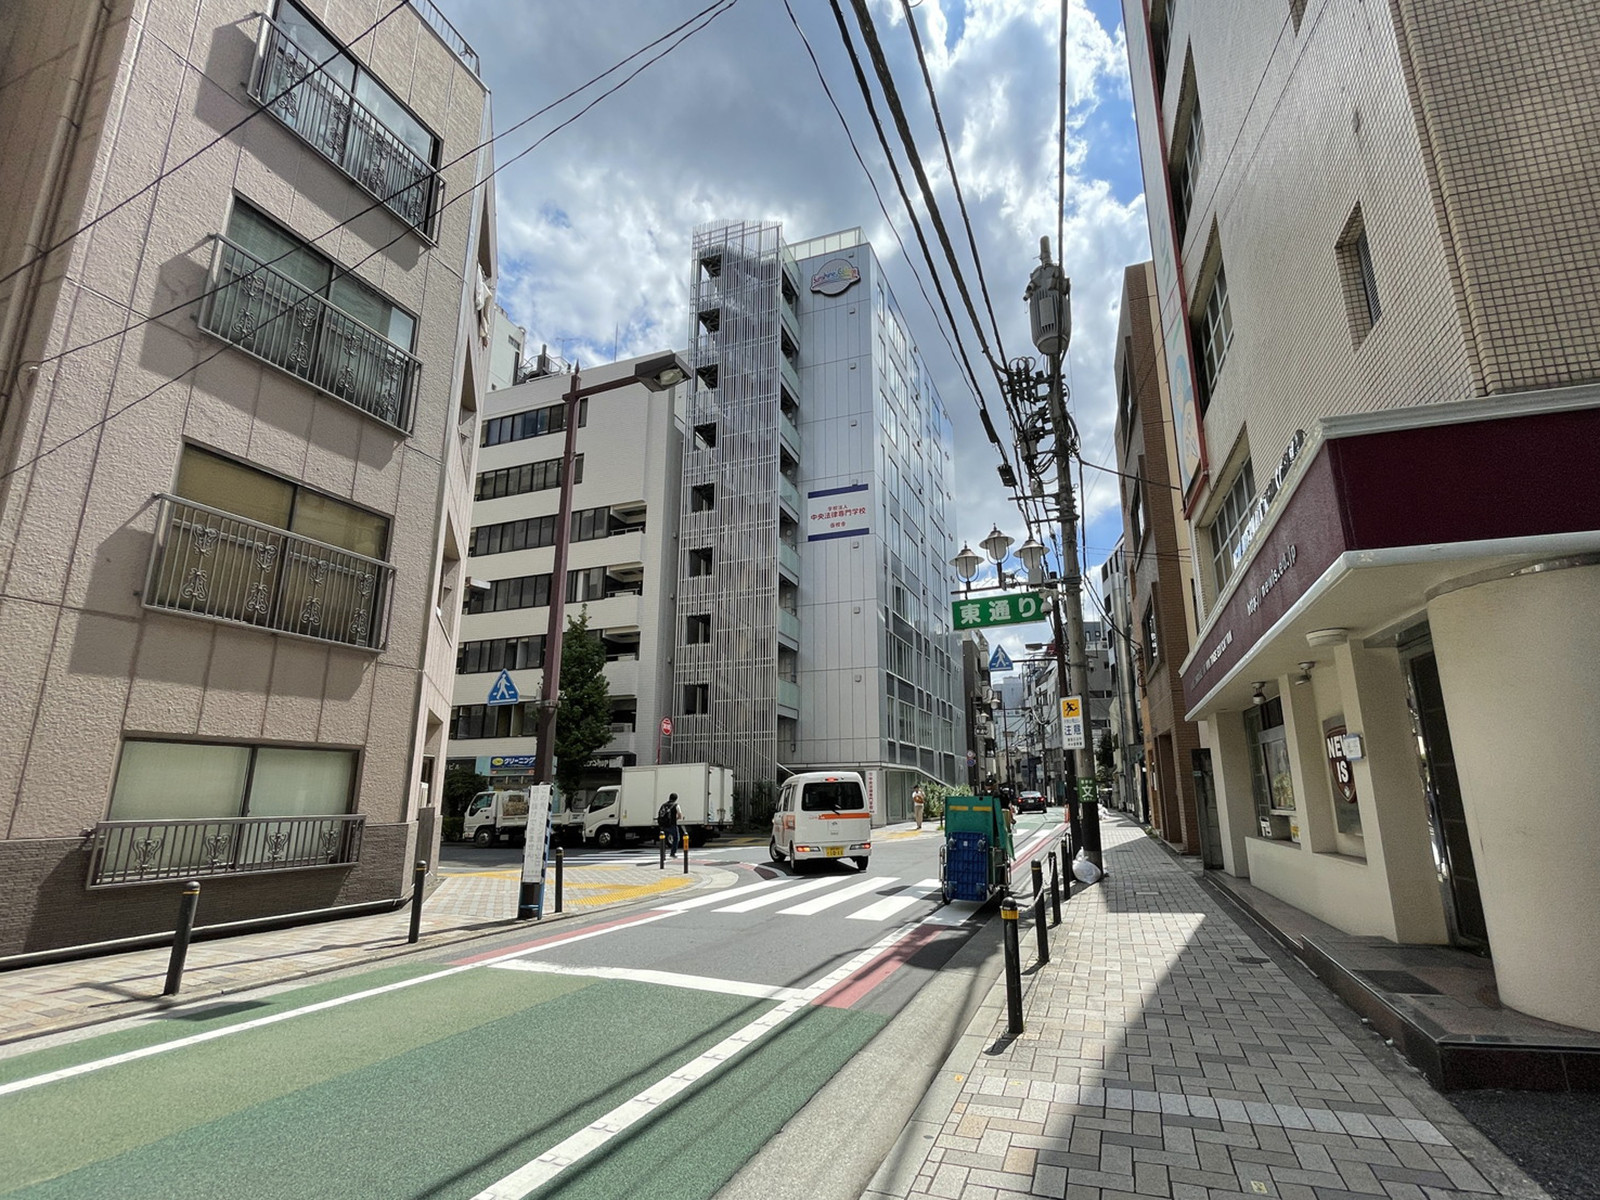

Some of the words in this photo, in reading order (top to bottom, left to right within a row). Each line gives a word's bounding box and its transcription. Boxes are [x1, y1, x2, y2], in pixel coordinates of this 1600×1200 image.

[811, 507, 866, 520] 中央法律専門学校
[959, 597, 1037, 625] 東通り
[1064, 723, 1082, 736] 注意
[503, 756, 536, 765] クリーニング
[1336, 760, 1349, 783] IS
[1081, 784, 1094, 798] 文
